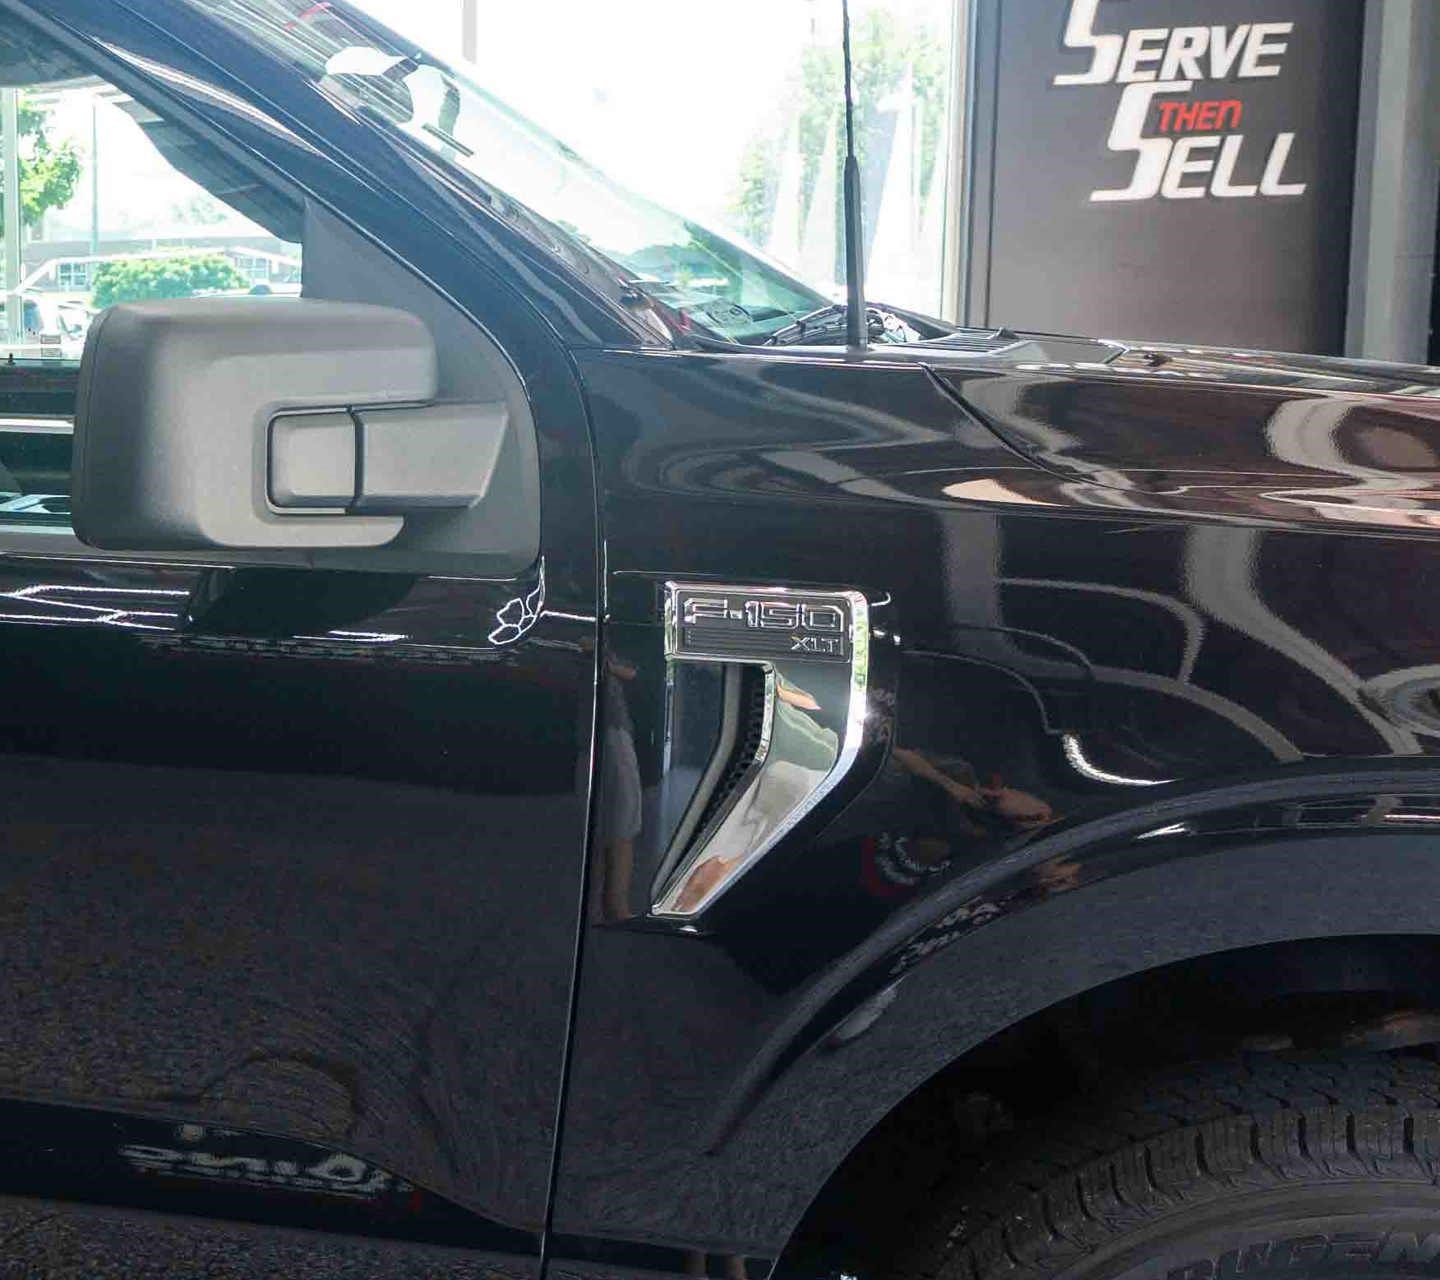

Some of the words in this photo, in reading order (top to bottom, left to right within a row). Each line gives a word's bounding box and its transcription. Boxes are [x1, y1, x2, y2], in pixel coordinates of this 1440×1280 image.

[1158, 99, 1243, 133] THEN
[1089, 80, 1307, 202] SELL
[683, 597, 845, 633] F-150
[791, 636, 839, 653] XLT
